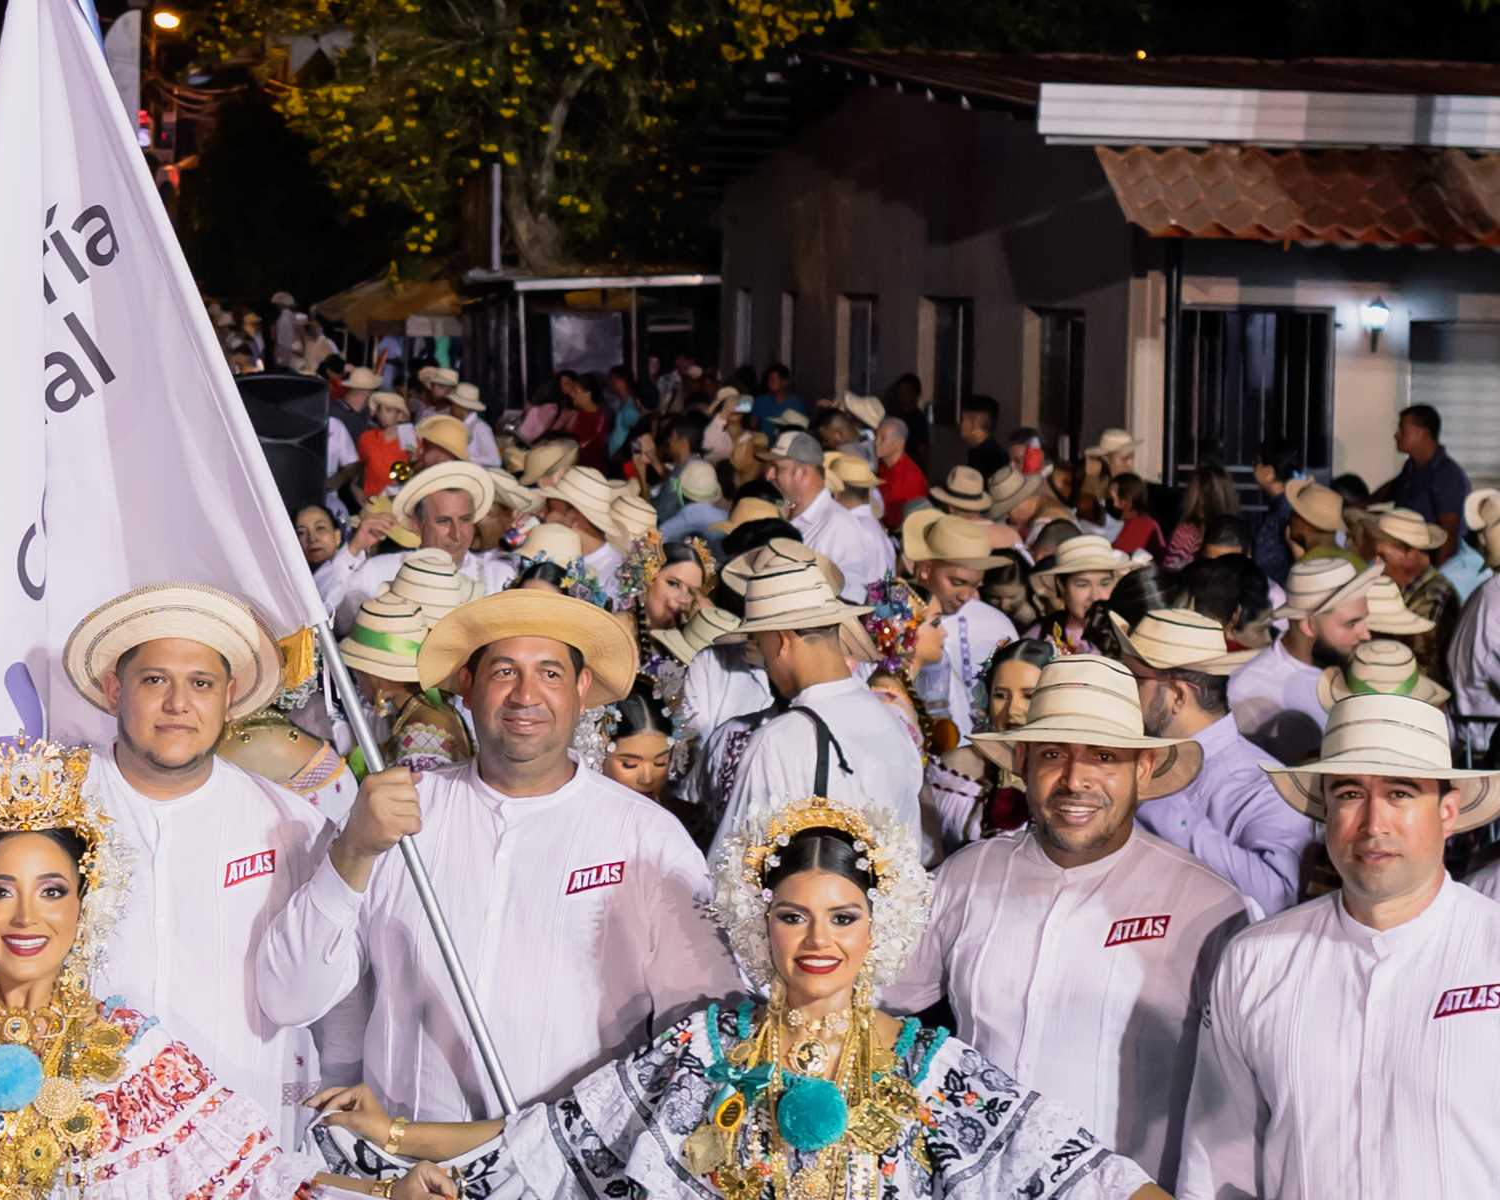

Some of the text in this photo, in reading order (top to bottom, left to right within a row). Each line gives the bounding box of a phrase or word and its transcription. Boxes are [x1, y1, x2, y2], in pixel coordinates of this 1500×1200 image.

[45, 311, 116, 413] al
[226, 853, 274, 884] ATLAS
[568, 863, 622, 892] ATLAS
[1106, 918, 1167, 944] ATLAS
[1437, 986, 1500, 1014] ATLAS
